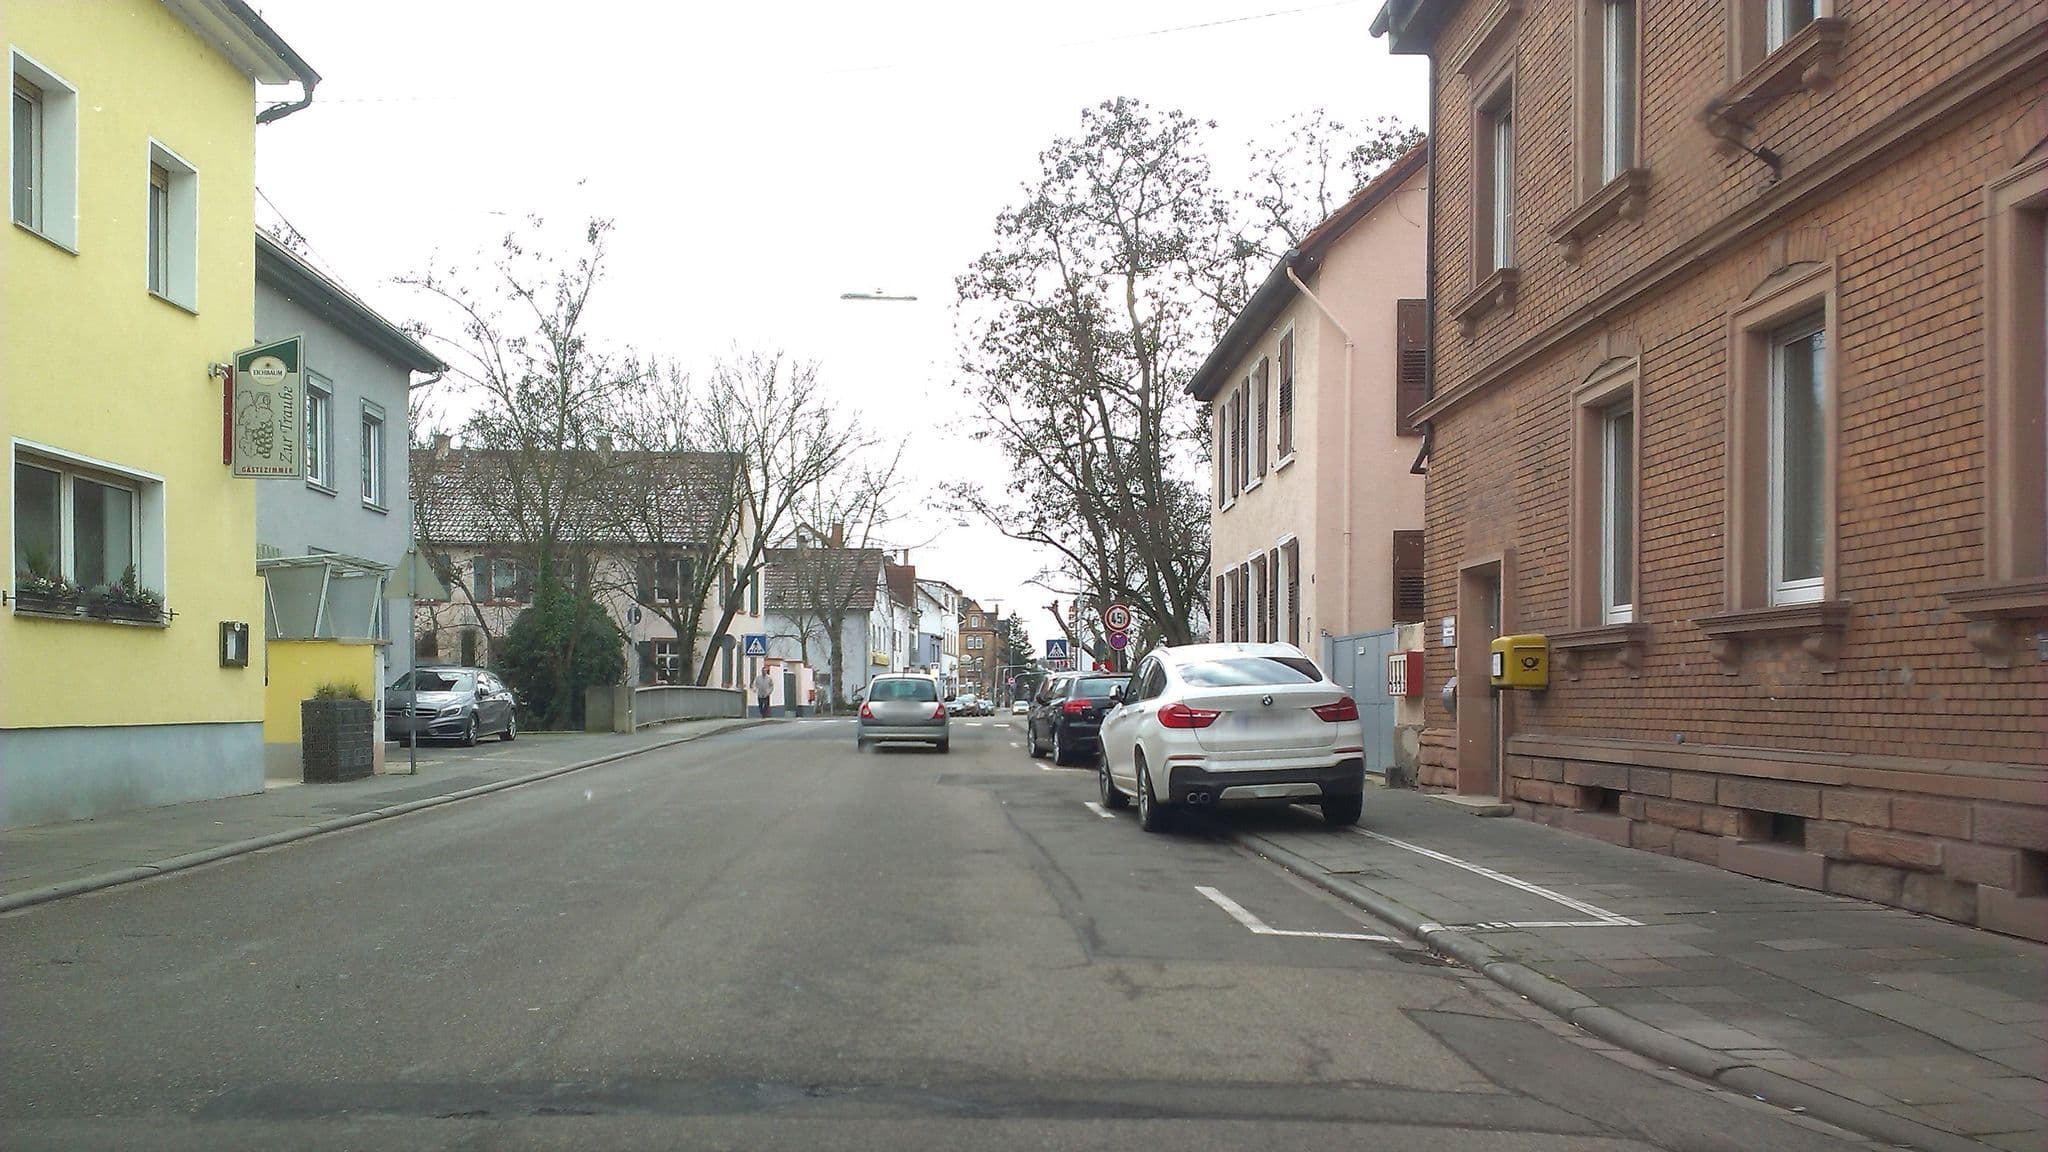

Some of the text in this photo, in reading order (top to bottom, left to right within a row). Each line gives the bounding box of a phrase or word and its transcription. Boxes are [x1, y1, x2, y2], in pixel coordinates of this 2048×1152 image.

[278, 385, 293, 465] Zur Traube
[241, 465, 293, 474] GÄSTEZIMMER
